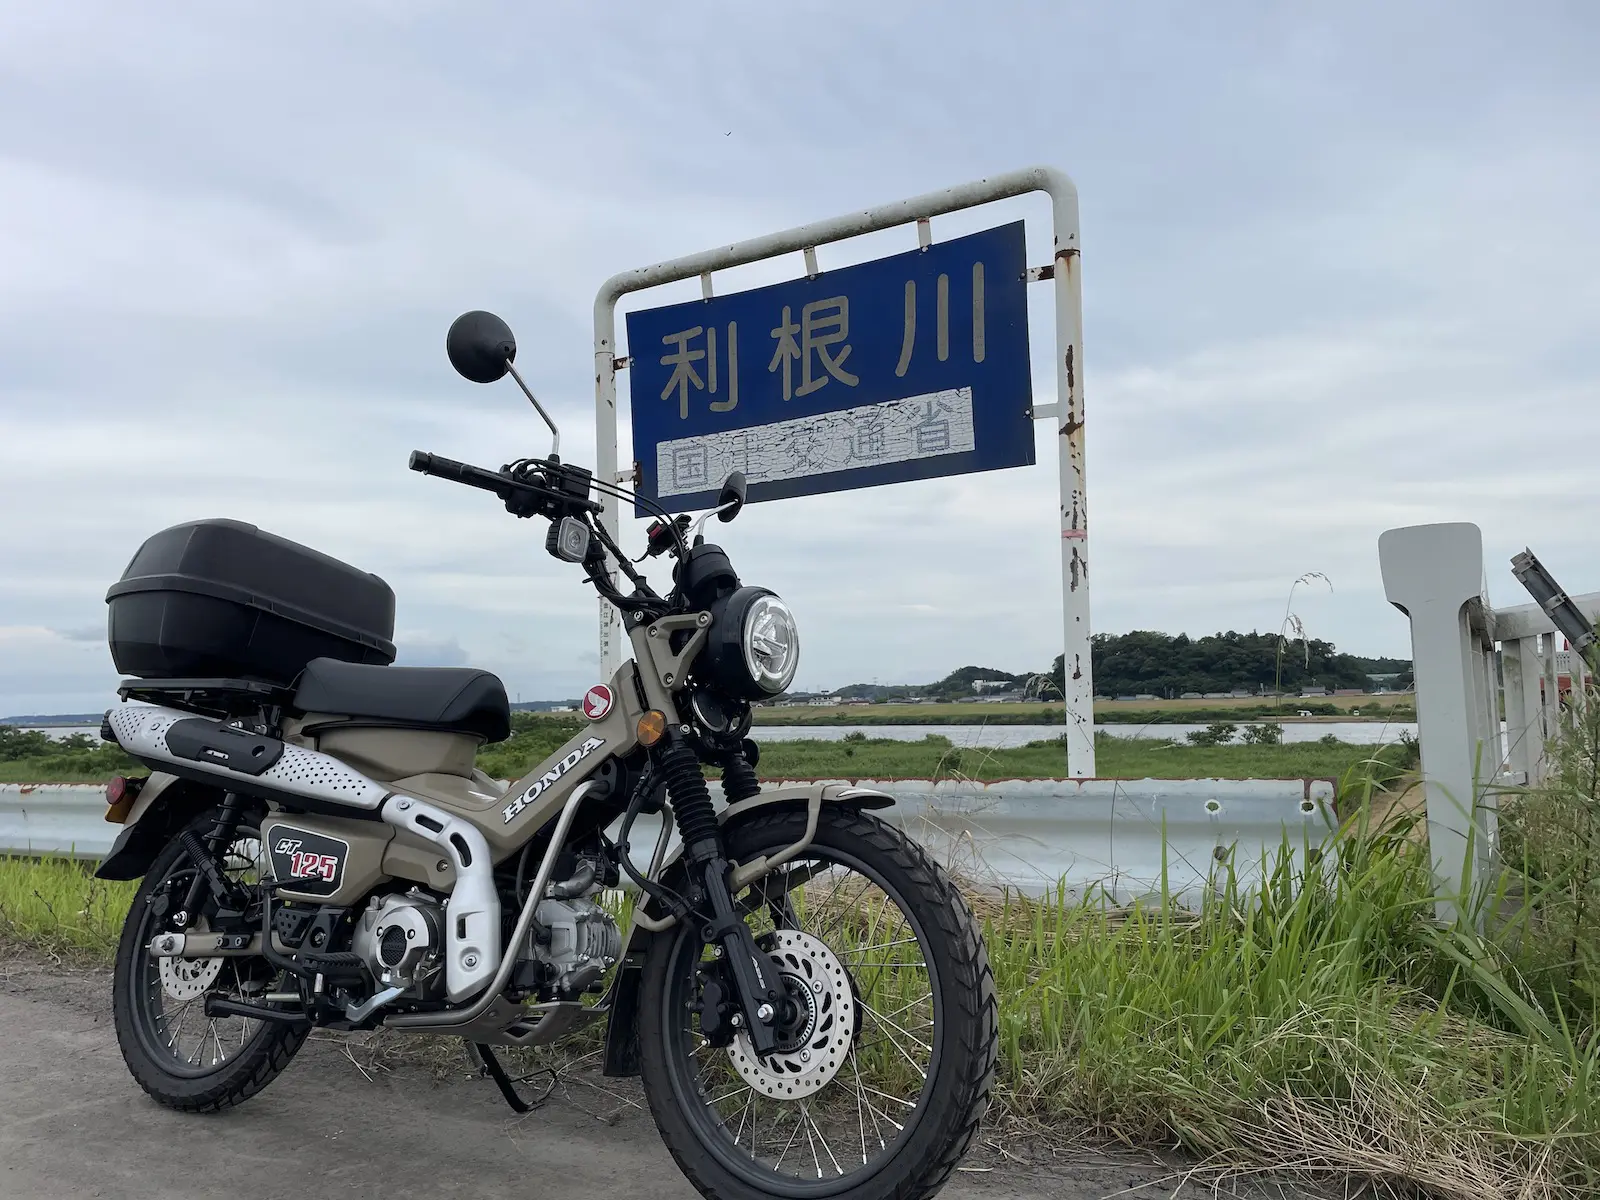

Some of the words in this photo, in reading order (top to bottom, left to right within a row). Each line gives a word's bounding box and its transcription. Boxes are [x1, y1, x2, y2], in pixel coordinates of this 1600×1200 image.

[659, 261, 985, 419] 利根川
[502, 736, 606, 824] HONDA
[274, 838, 303, 855] CT
[290, 851, 338, 882] 125
